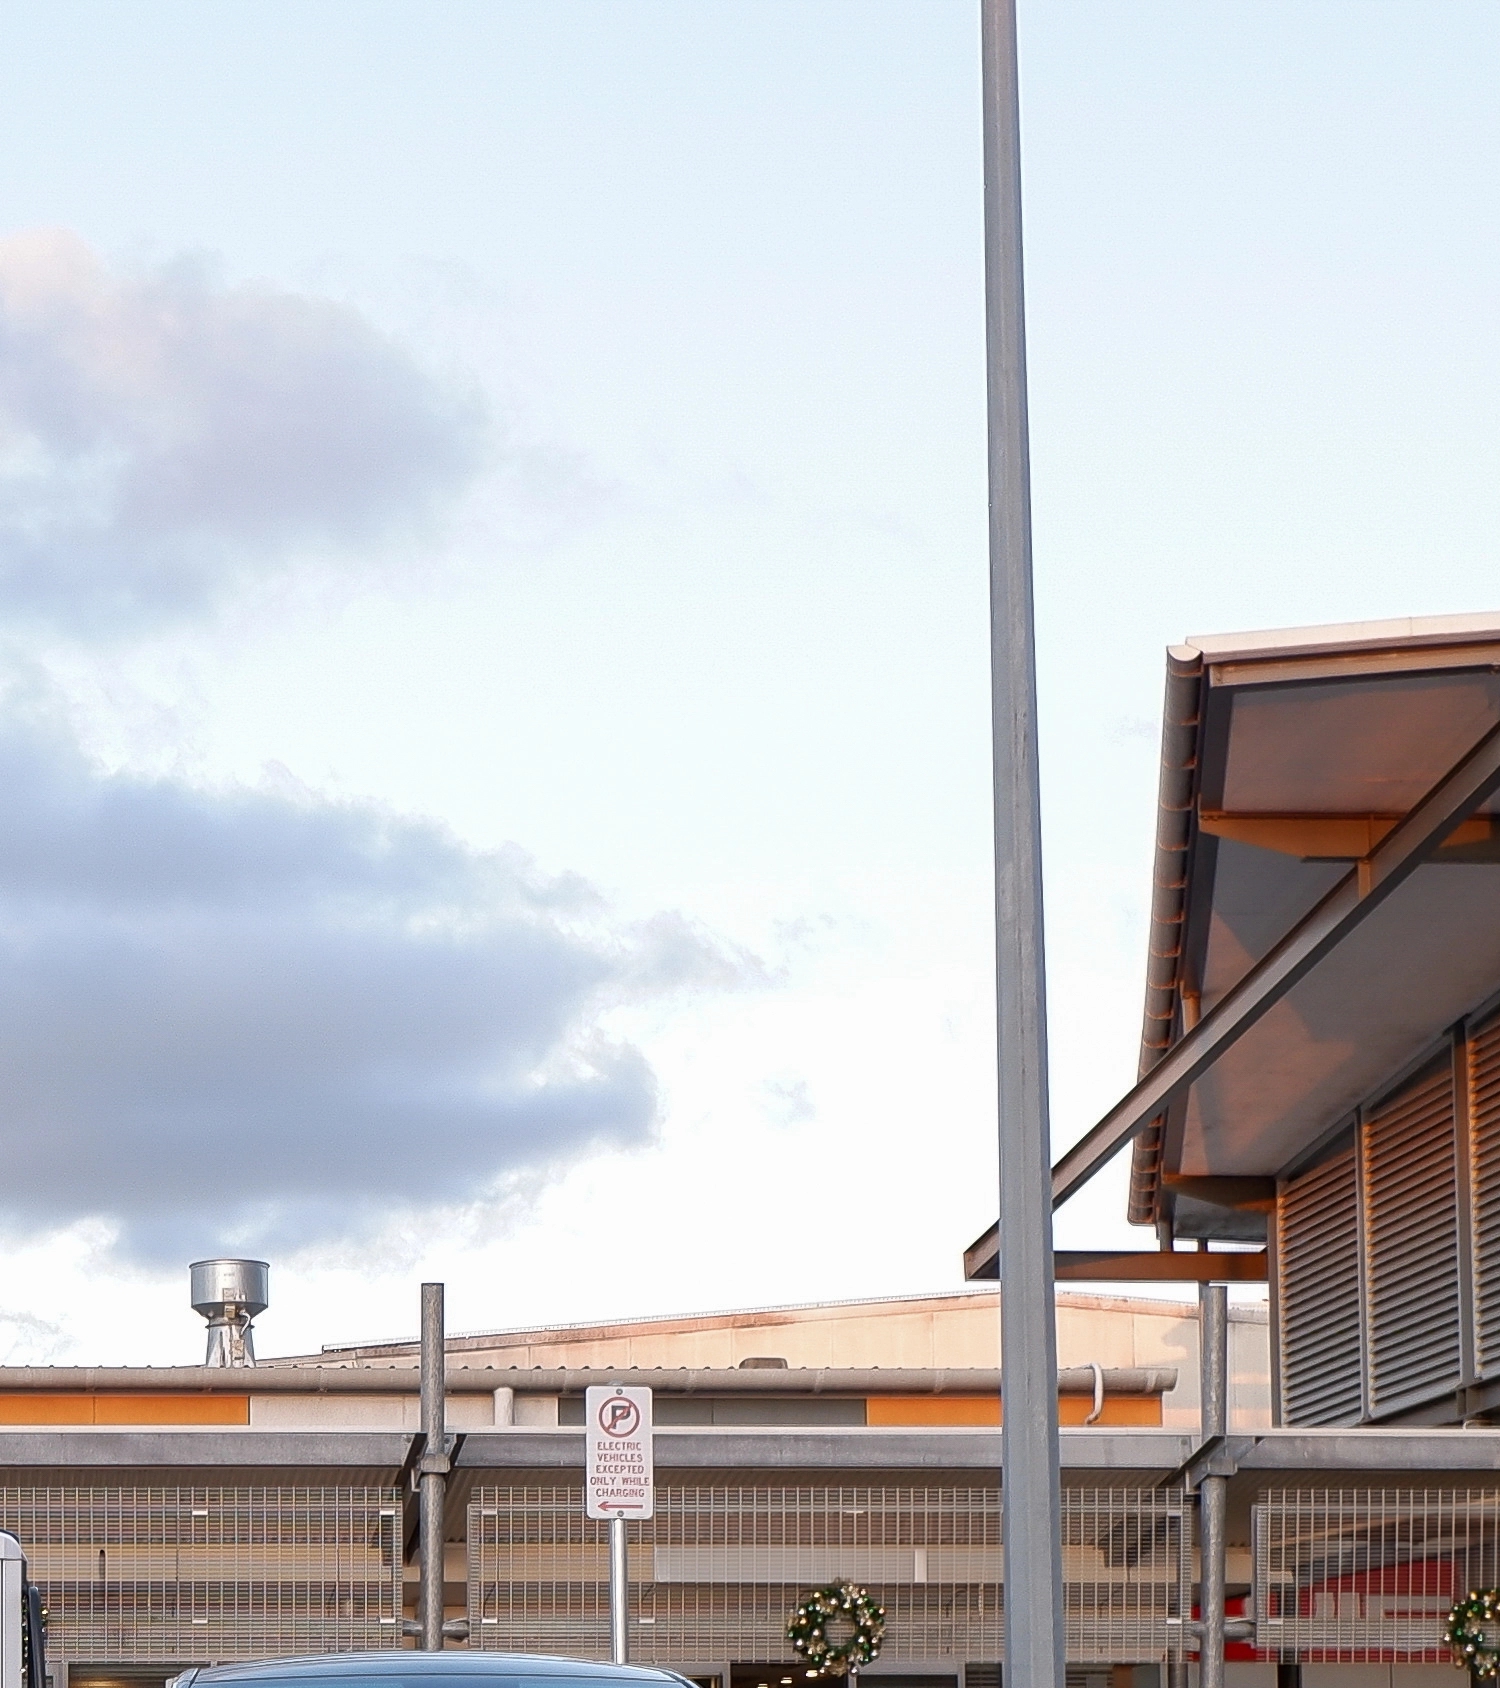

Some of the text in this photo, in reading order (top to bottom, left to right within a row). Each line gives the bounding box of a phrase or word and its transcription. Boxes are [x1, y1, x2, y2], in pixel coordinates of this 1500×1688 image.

[597, 1441, 642, 1451] ELECTRIC
[597, 1453, 643, 1463] VEHICLES
[596, 1465, 645, 1474] EXCEPTED
[590, 1477, 650, 1486] ONLY WHILE
[596, 1488, 645, 1498] CHARGING
